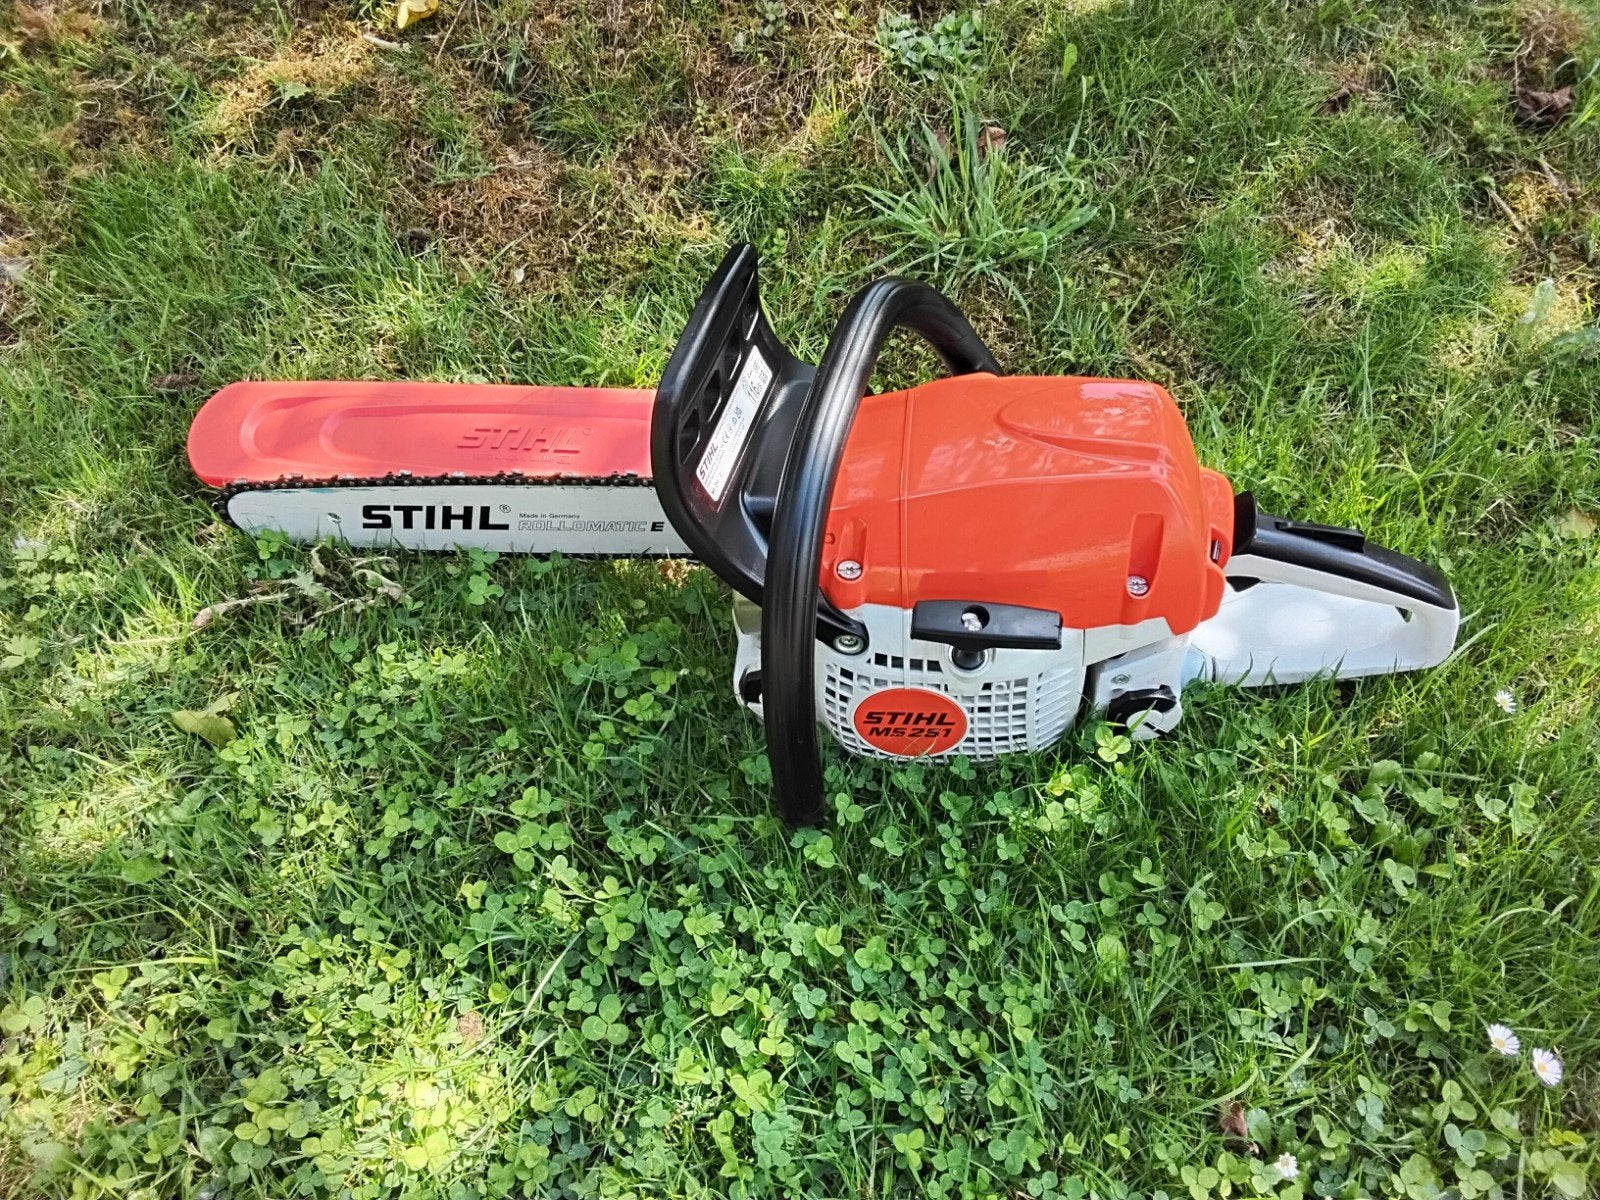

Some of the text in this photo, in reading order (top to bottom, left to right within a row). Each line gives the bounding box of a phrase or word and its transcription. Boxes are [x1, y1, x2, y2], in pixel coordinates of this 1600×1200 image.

[699, 442, 719, 479] STIHL
[518, 520, 665, 532] ROLLOMATIC E
[862, 711, 956, 726] STIHL
[868, 727, 952, 738] MS 251
